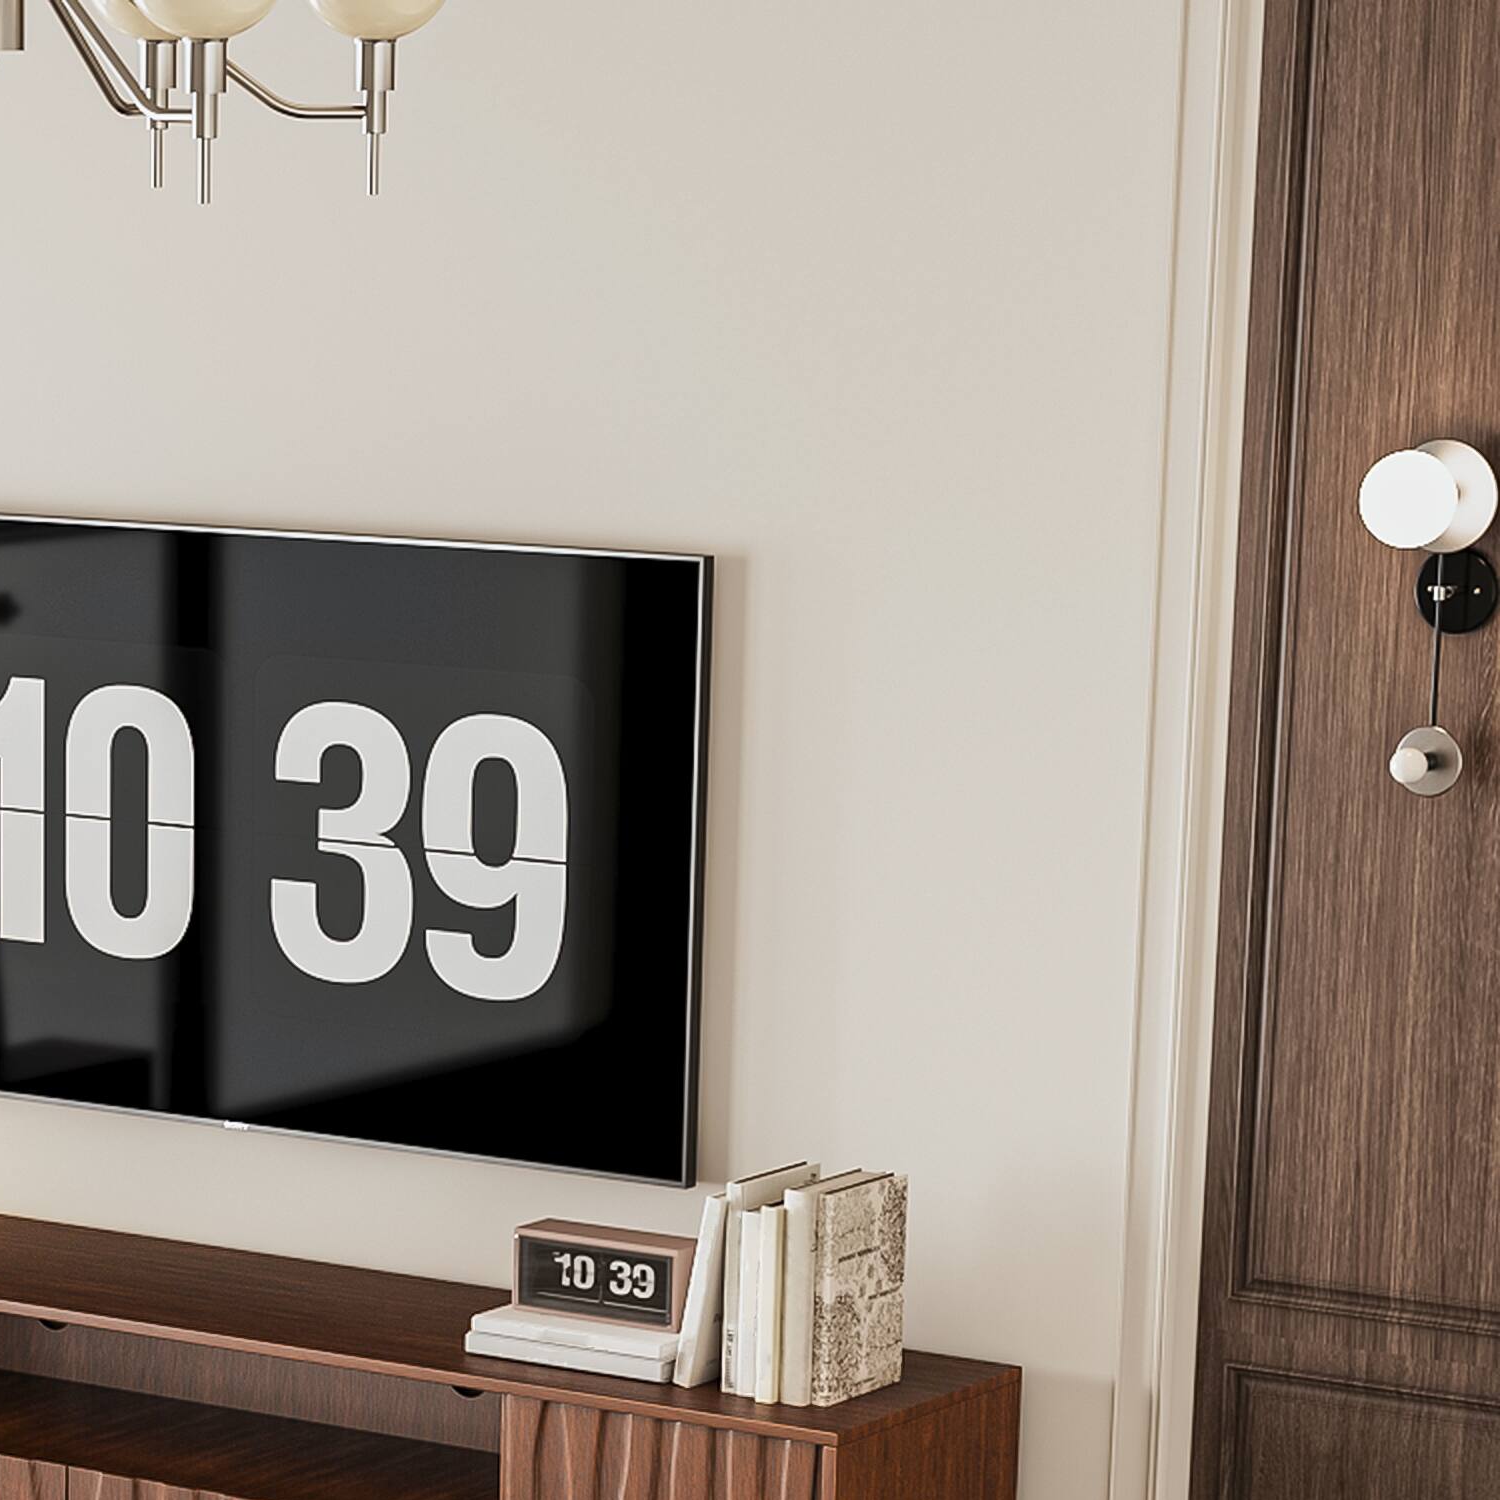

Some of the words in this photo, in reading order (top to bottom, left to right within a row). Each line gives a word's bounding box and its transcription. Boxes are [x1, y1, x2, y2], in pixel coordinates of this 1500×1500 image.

[269, 701, 569, 1002] 39
[553, 1253, 595, 1290] 10
[609, 1260, 656, 1299] 39
